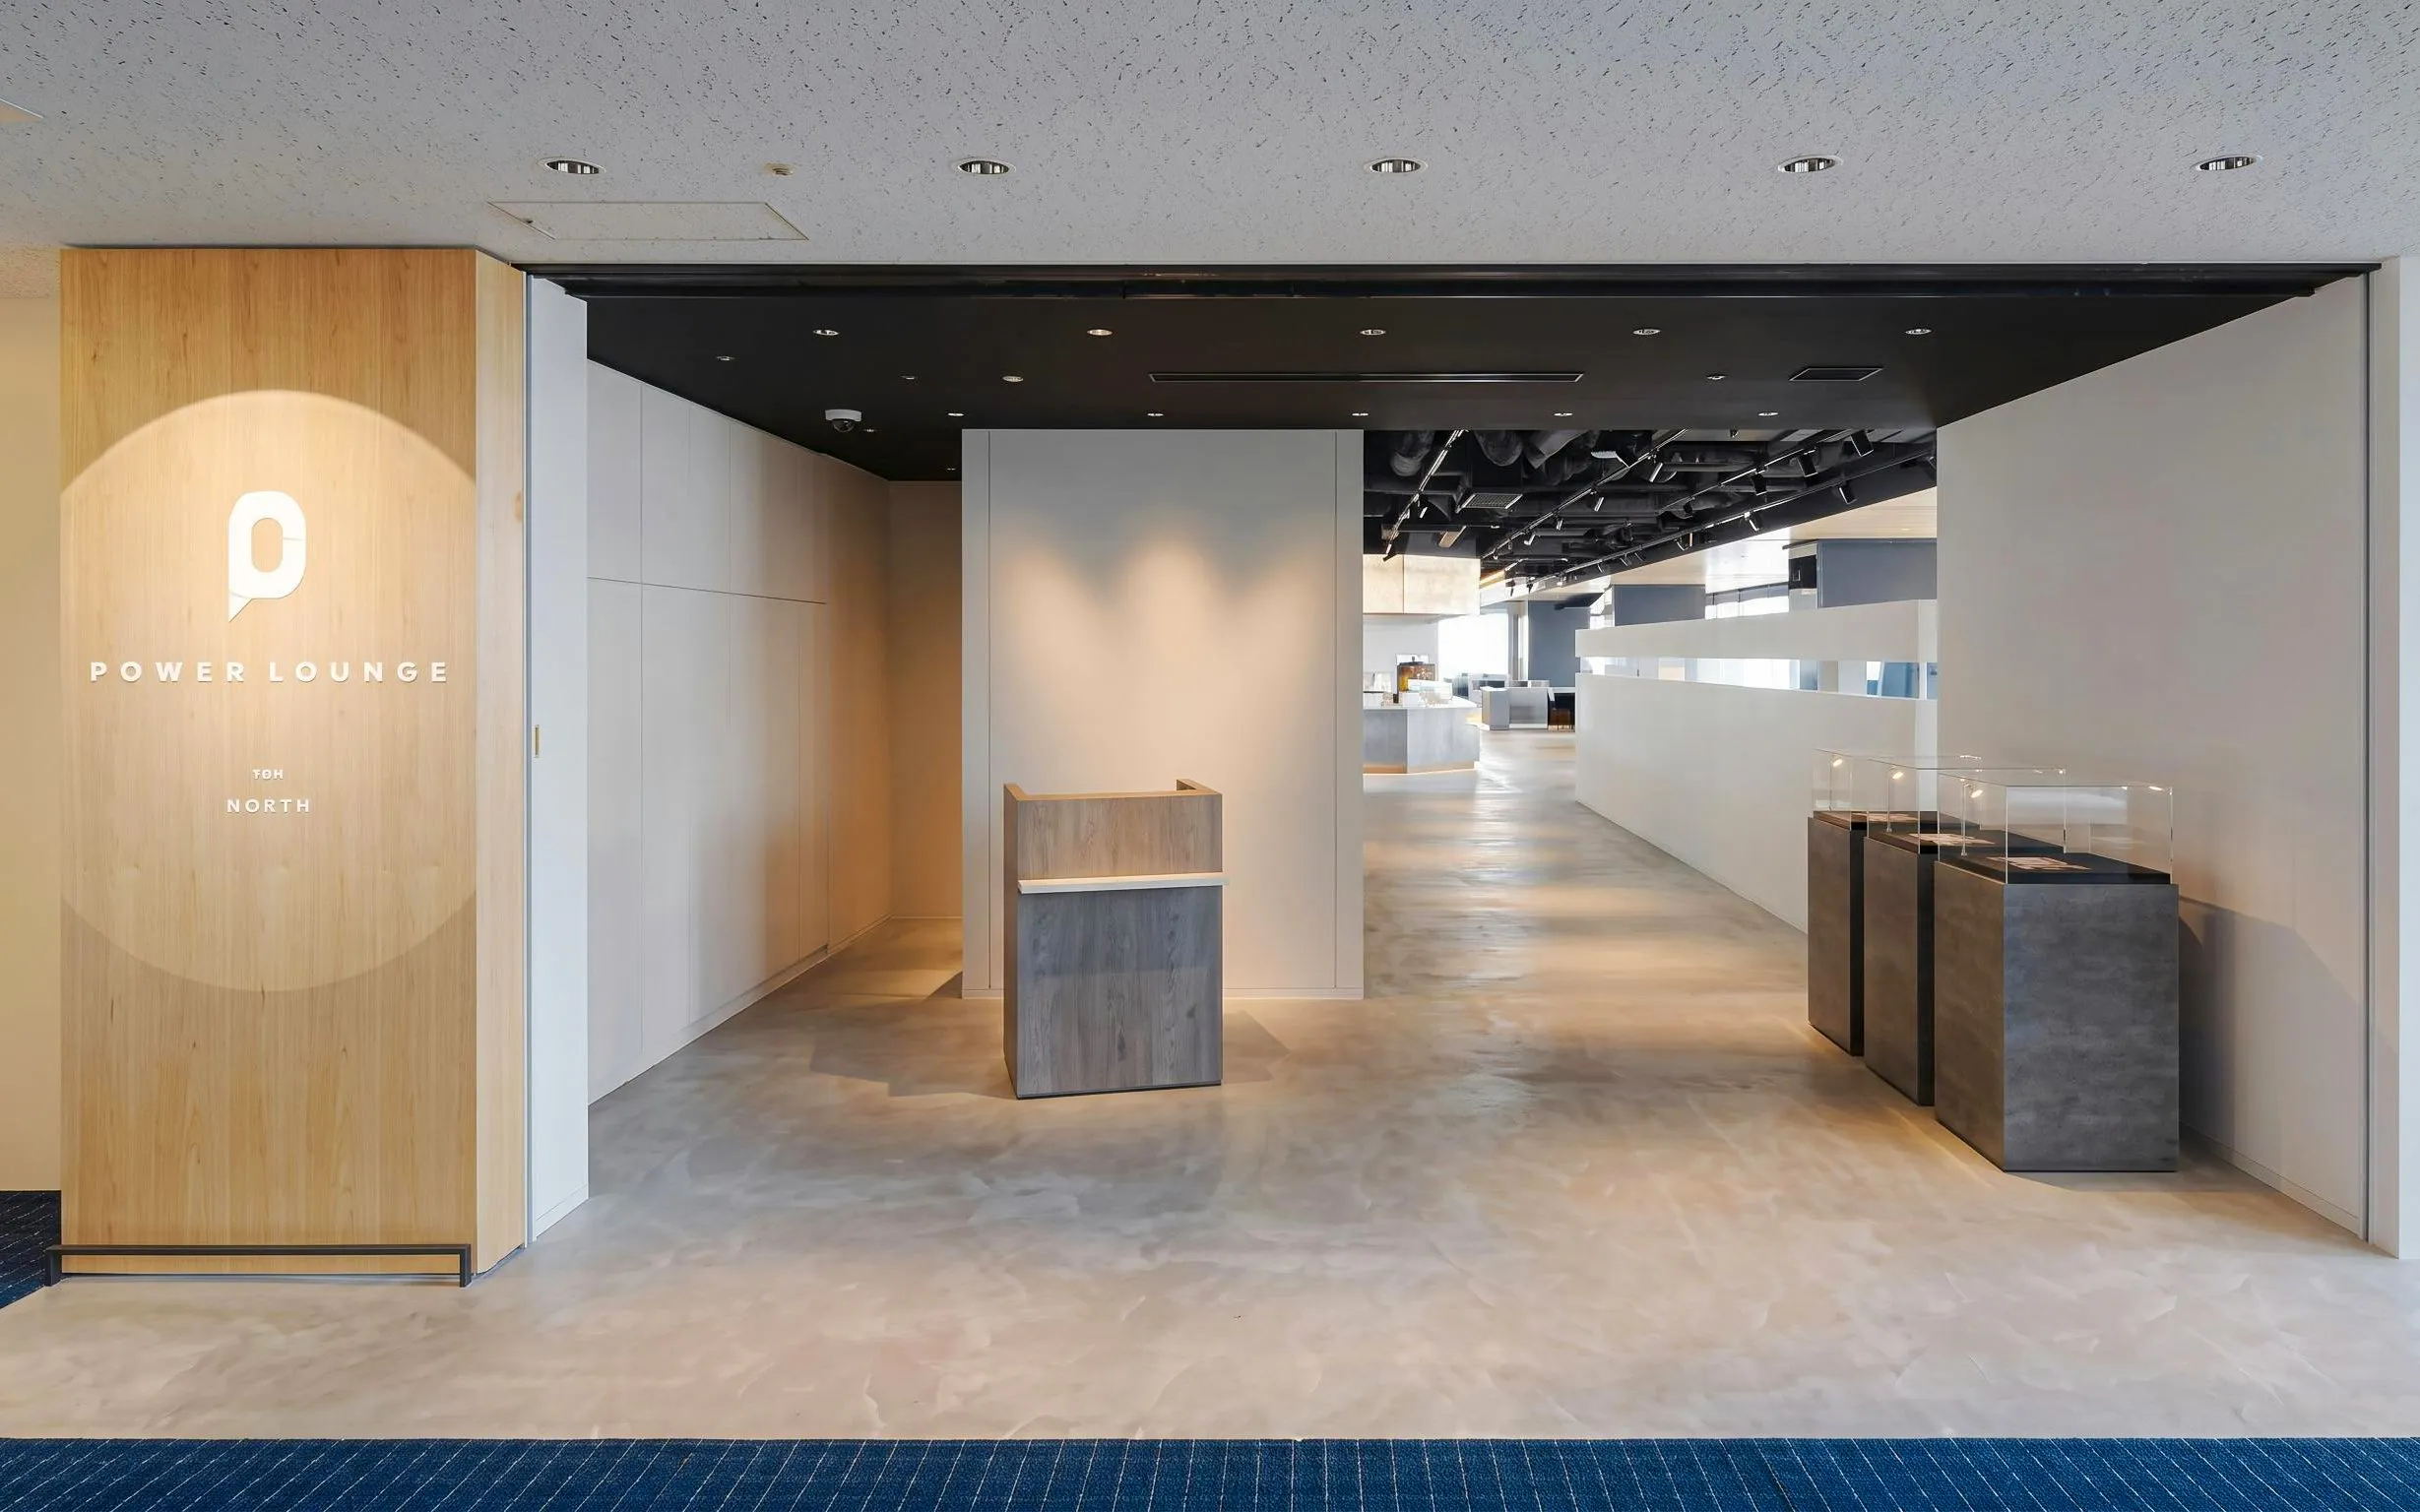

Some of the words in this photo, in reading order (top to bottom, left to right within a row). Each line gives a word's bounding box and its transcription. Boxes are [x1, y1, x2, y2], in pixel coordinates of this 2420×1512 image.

[90, 661, 245, 683] POWER
[269, 661, 448, 683] LOUNGE
[226, 798, 309, 814] NORTH
